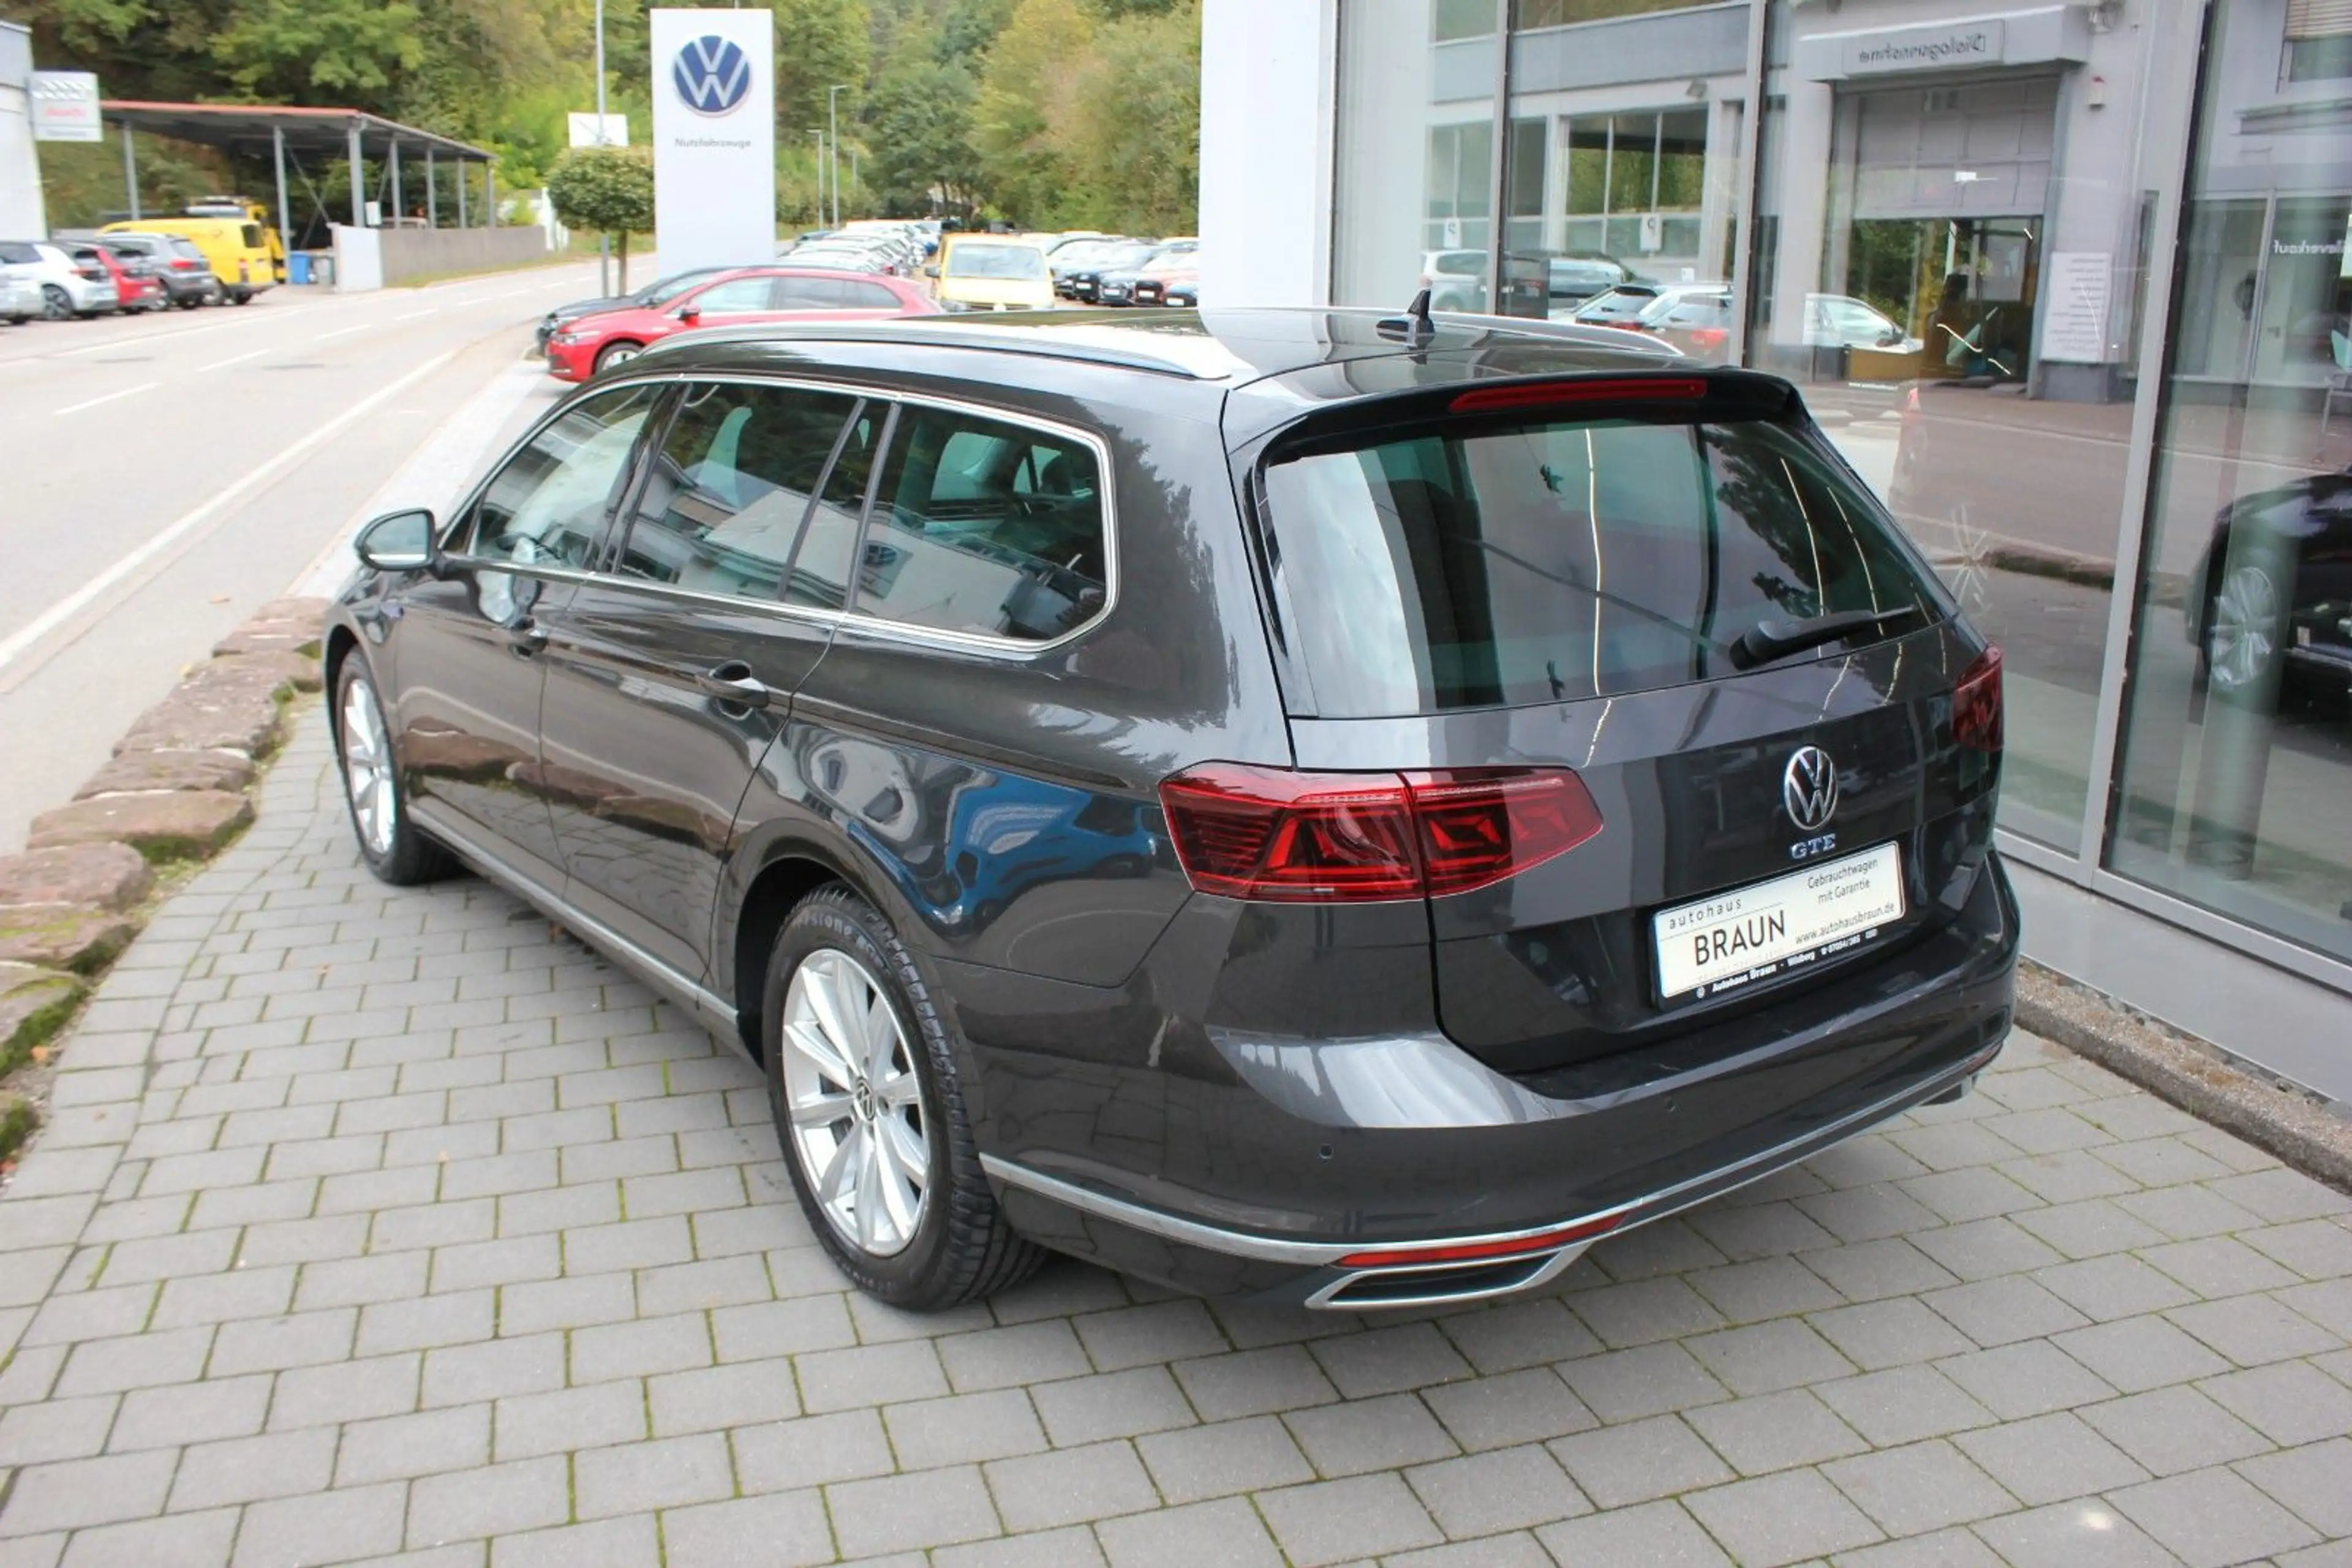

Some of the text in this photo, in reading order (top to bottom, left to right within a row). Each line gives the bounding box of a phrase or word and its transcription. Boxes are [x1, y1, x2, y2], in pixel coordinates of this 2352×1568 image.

[675, 137, 752, 149] Nutzfahrzeuge
[1791, 834, 1836, 859] GTE
[1807, 859, 1878, 889] Gebrauchtwagen
[1818, 878, 1870, 905] mit Garantie
[1669, 899, 1742, 930] autohaus
[1795, 900, 1894, 944] www.autohausbraun.de
[1695, 910, 1785, 966] BRAUN
[1749, 962, 1777, 979] Braun
